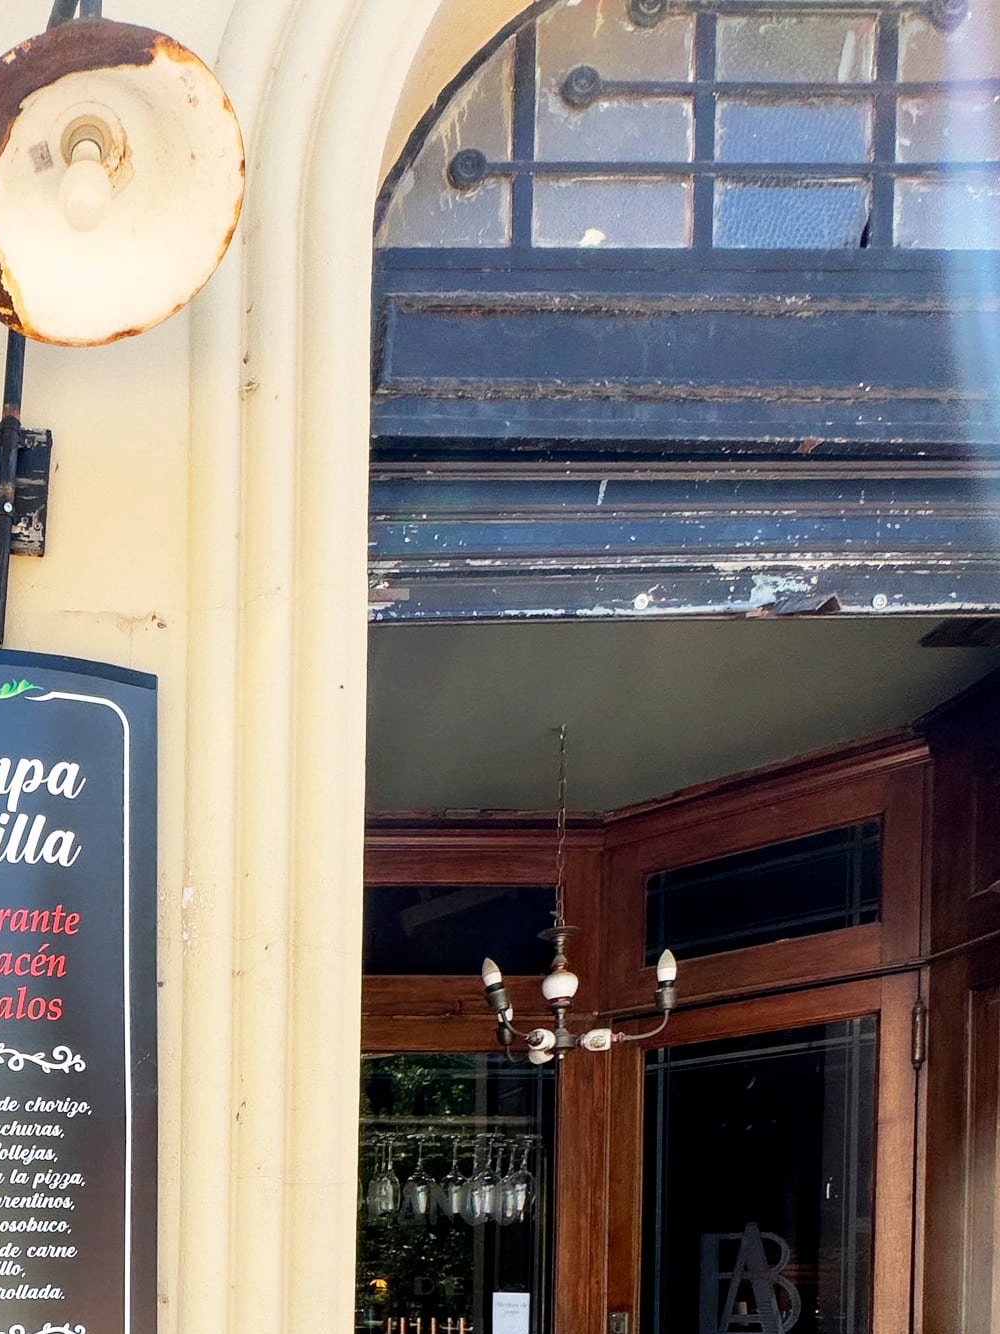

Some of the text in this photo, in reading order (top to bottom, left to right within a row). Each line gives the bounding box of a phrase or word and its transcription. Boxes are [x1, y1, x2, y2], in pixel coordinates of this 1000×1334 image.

[25, 1097, 93, 1118] chorizo,
[10, 1168, 28, 1184] la
[32, 1170, 86, 1189] pizza,
[0, 1217, 72, 1234] osobuco,
[26, 1246, 77, 1258] carne
